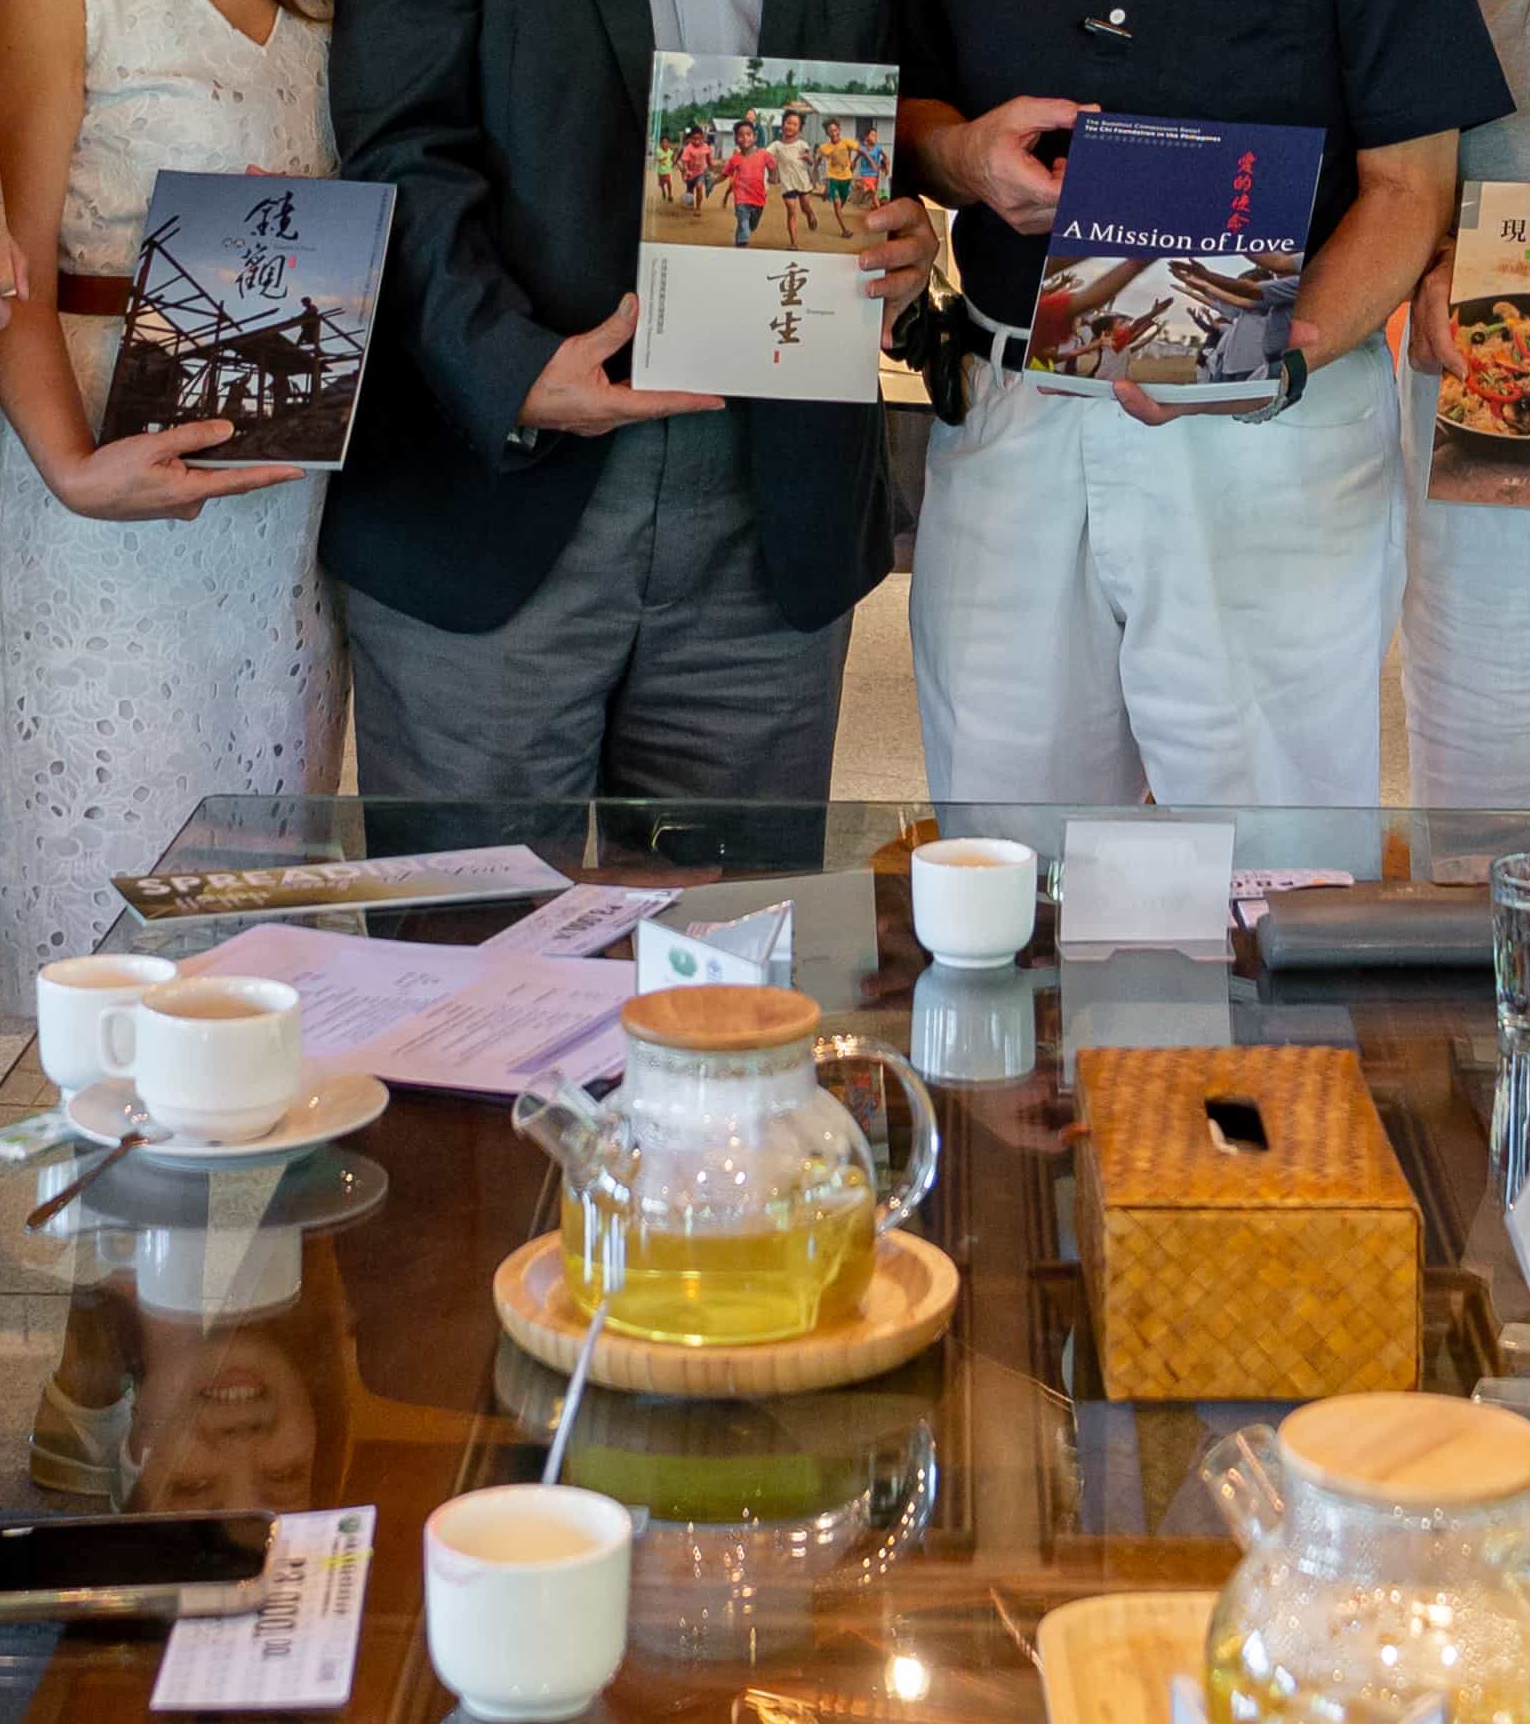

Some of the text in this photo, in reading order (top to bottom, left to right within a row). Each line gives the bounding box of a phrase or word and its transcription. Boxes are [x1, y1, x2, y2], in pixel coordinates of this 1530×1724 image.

[1063, 220, 1296, 253] A Mission of Love
